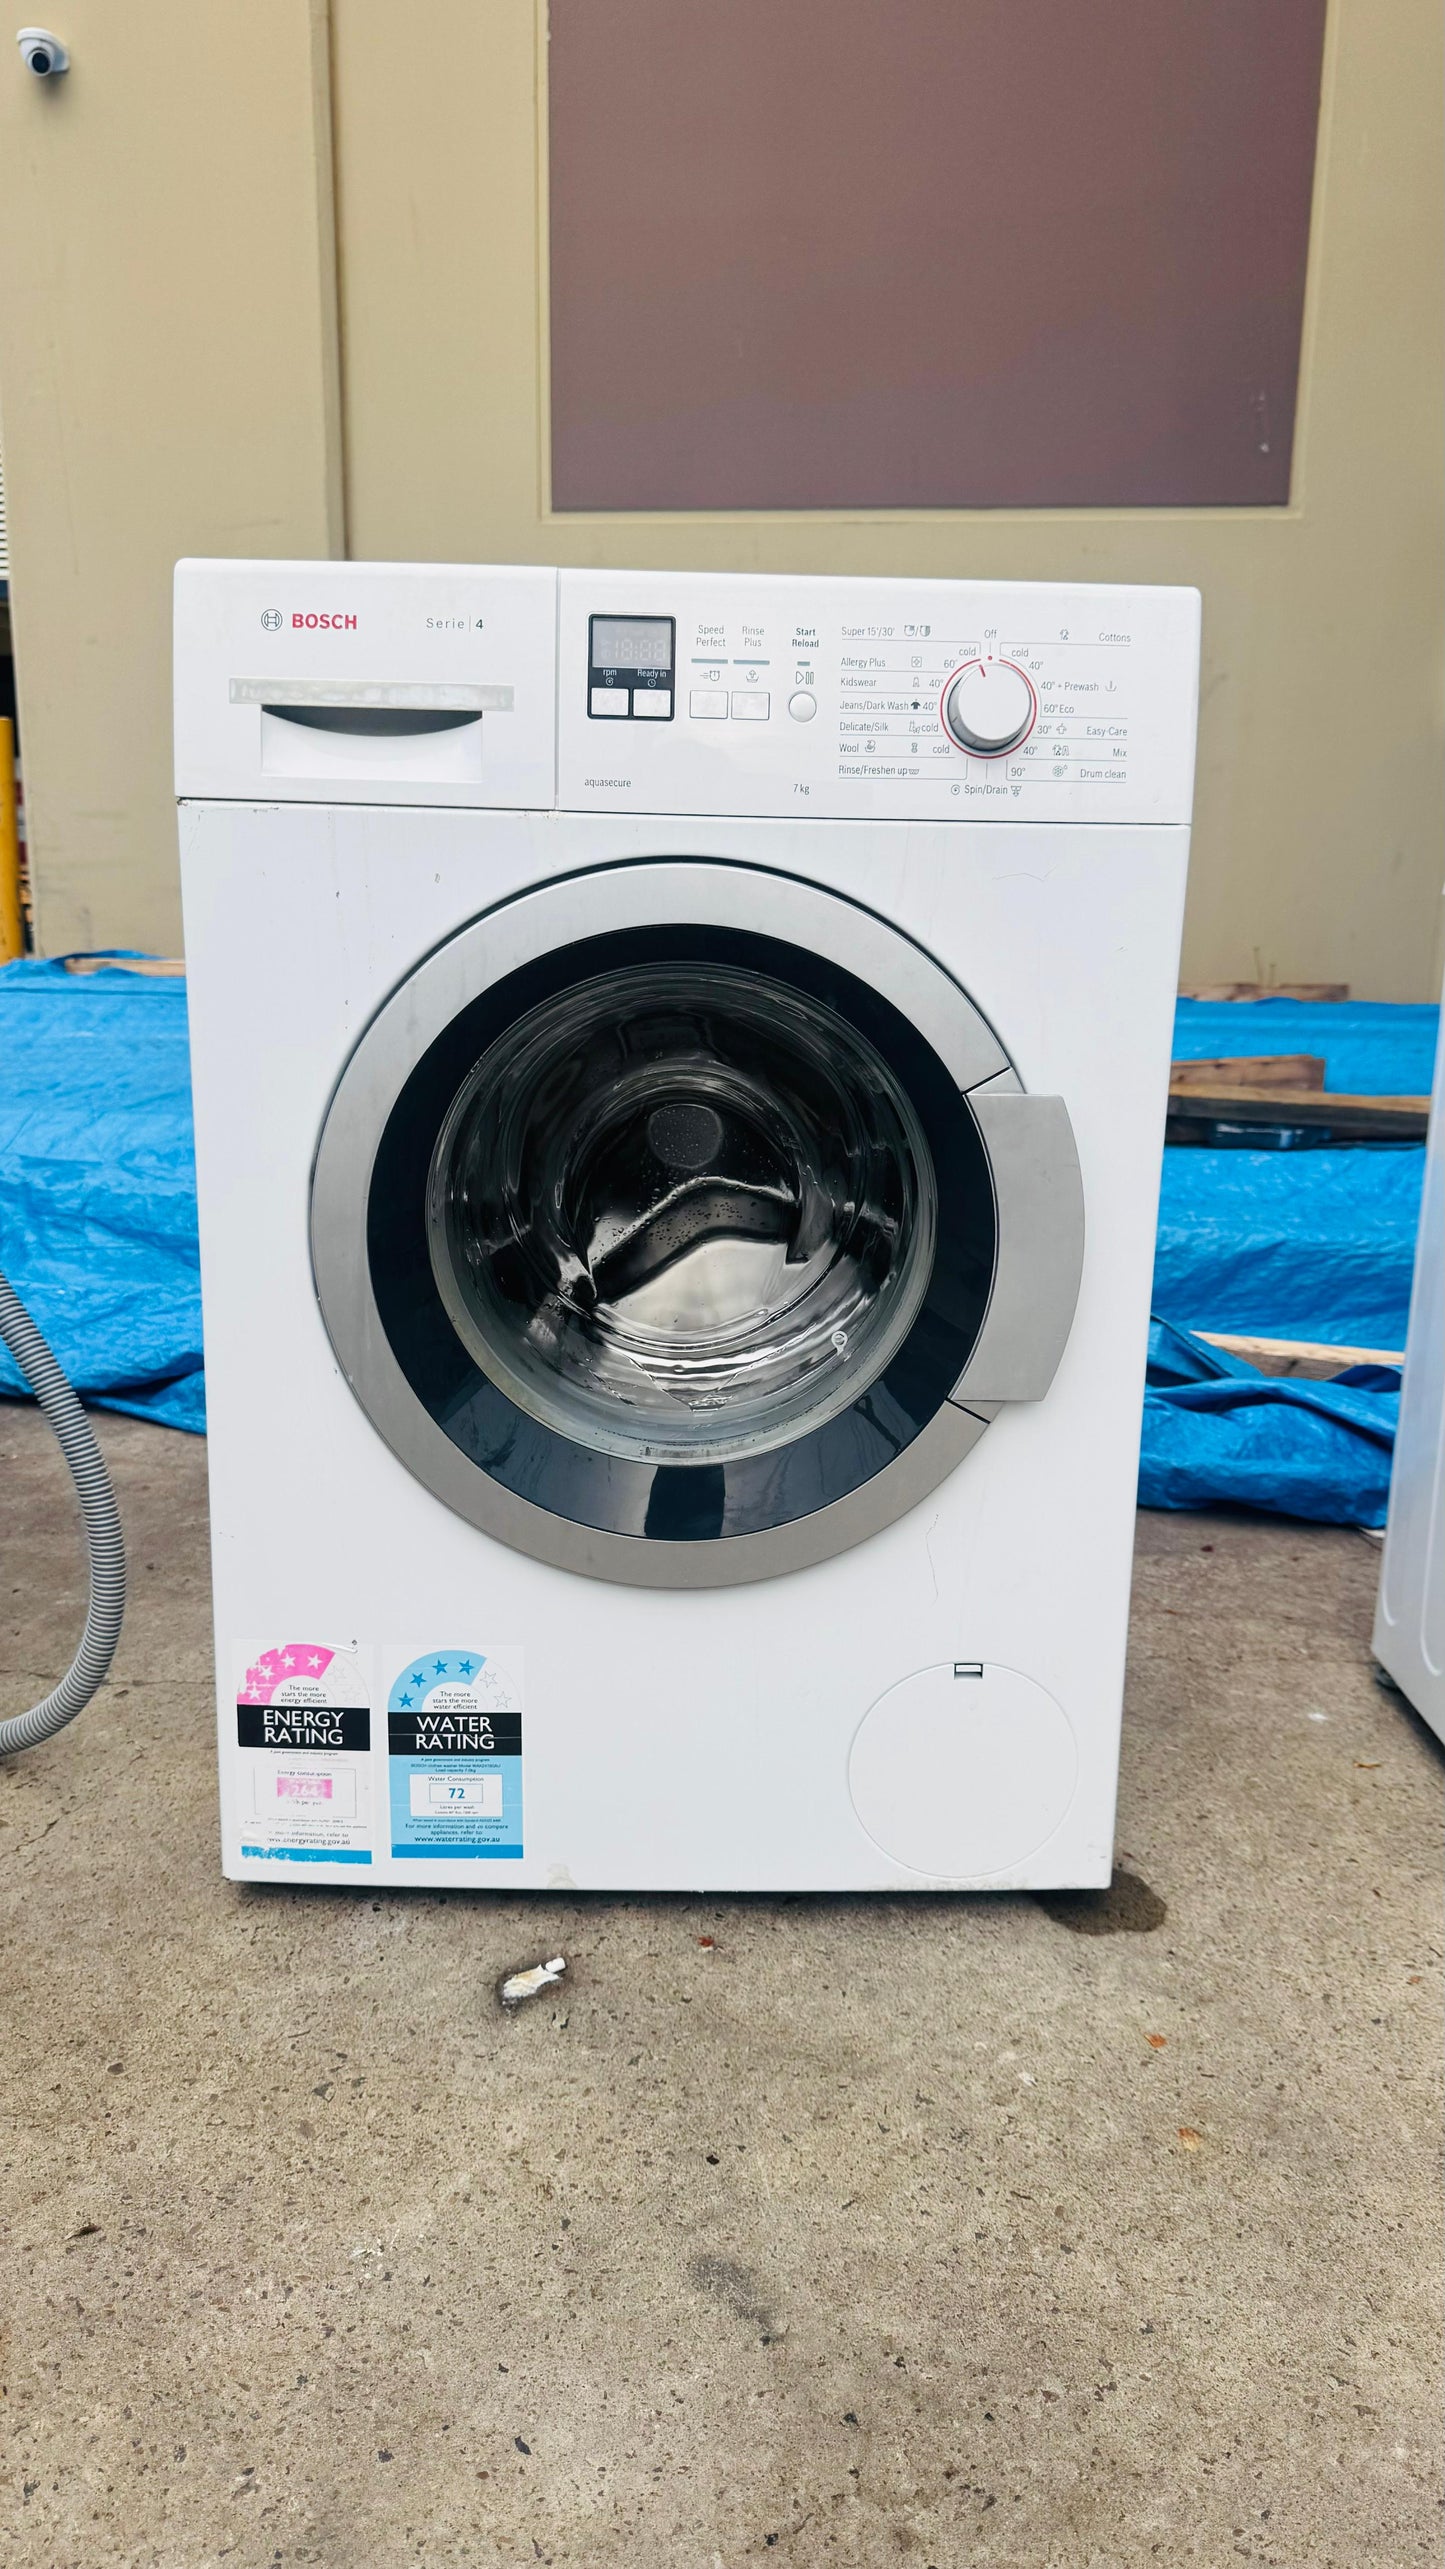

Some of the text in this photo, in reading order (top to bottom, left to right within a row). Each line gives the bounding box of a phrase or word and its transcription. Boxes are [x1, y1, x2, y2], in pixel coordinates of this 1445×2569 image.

[292, 613, 358, 630] BOSCH
[426, 617, 484, 629] Serie 4
[698, 625, 724, 637] Speed
[742, 626, 765, 636] Rinse
[796, 627, 816, 637] Start
[841, 626, 865, 637] Super
[984, 629, 997, 639] Off
[696, 637, 726, 647] Perfect
[744, 637, 762, 647] Plus
[1098, 632, 1131, 642] Cottons
[791, 638, 819, 648] Reload
[958, 647, 977, 656] cold
[1011, 648, 1029, 657] cold
[840, 657, 868, 669] Allergy
[869, 657, 886, 667] Plus
[1028, 661, 1044, 670] 40°
[602, 669, 617, 677] rpm
[637, 669, 667, 679] Ready in
[840, 677, 877, 687] Kidswear
[1040, 681, 1056, 690] 40°
[1064, 681, 1099, 691] Prewash
[839, 700, 938, 711] Jeans/Dark Wash 40°
[1043, 704, 1075, 714] 60° Eco
[839, 721, 939, 732] Delicate/Silk cold
[1037, 725, 1128, 737] 30° Easy Care
[839, 743, 950, 754] Wool cold
[1023, 746, 1127, 758] 40° Mix
[838, 764, 908, 776] Rinse/Freshen up
[1010, 767, 1127, 779] 90° Drum clean
[584, 778, 632, 788] aquasecure
[793, 783, 810, 795] 7 kg
[964, 784, 1008, 795] Spin/Drain
[263, 1709, 344, 1728] ENERGY
[416, 1716, 493, 1732] WATER
[264, 1727, 344, 1745] RATING
[415, 1733, 495, 1750] RATING
[448, 1787, 466, 1799] 72
[414, 1836, 501, 1844] www.waterrating.gov.au
